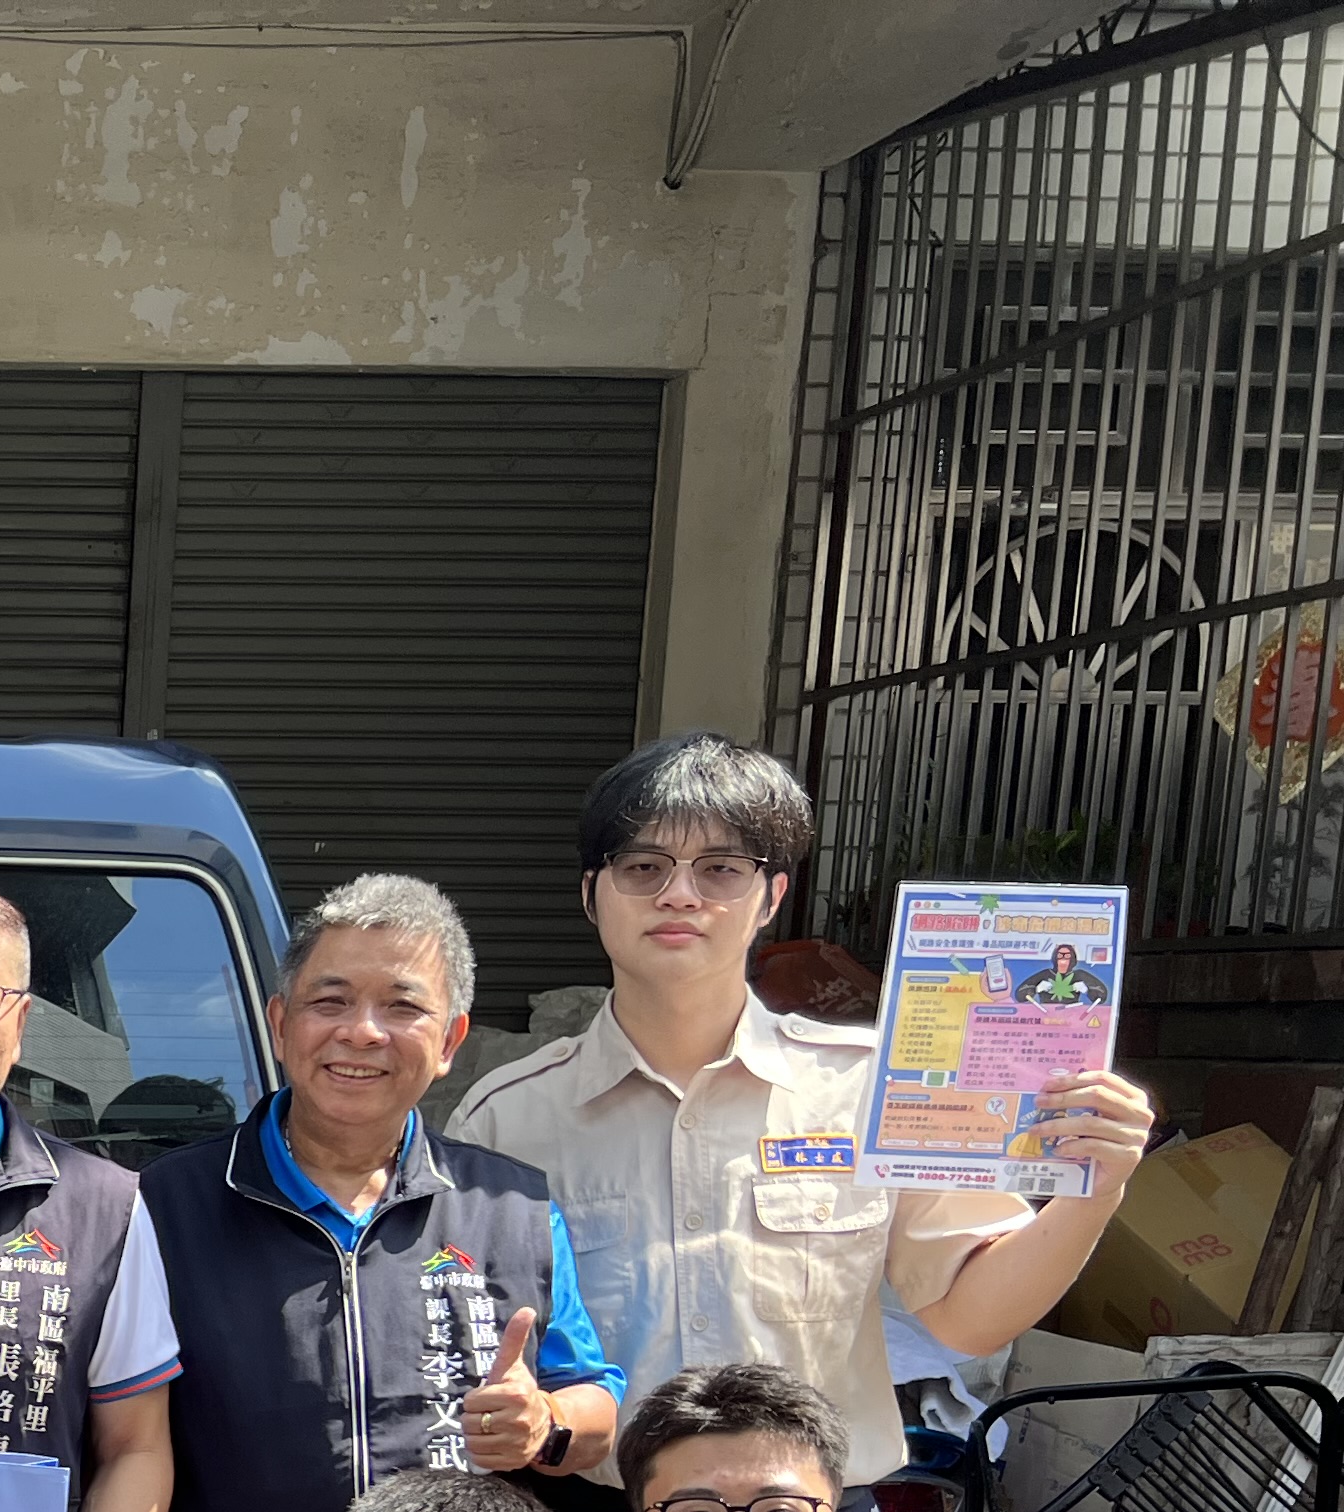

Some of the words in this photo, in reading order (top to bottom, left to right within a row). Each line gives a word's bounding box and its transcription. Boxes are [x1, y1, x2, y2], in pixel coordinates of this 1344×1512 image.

[0, 1256, 67, 1276] 臺中市政府
[23, 1285, 71, 1432] 南區福平里
[466, 1296, 500, 1388] 南區區
